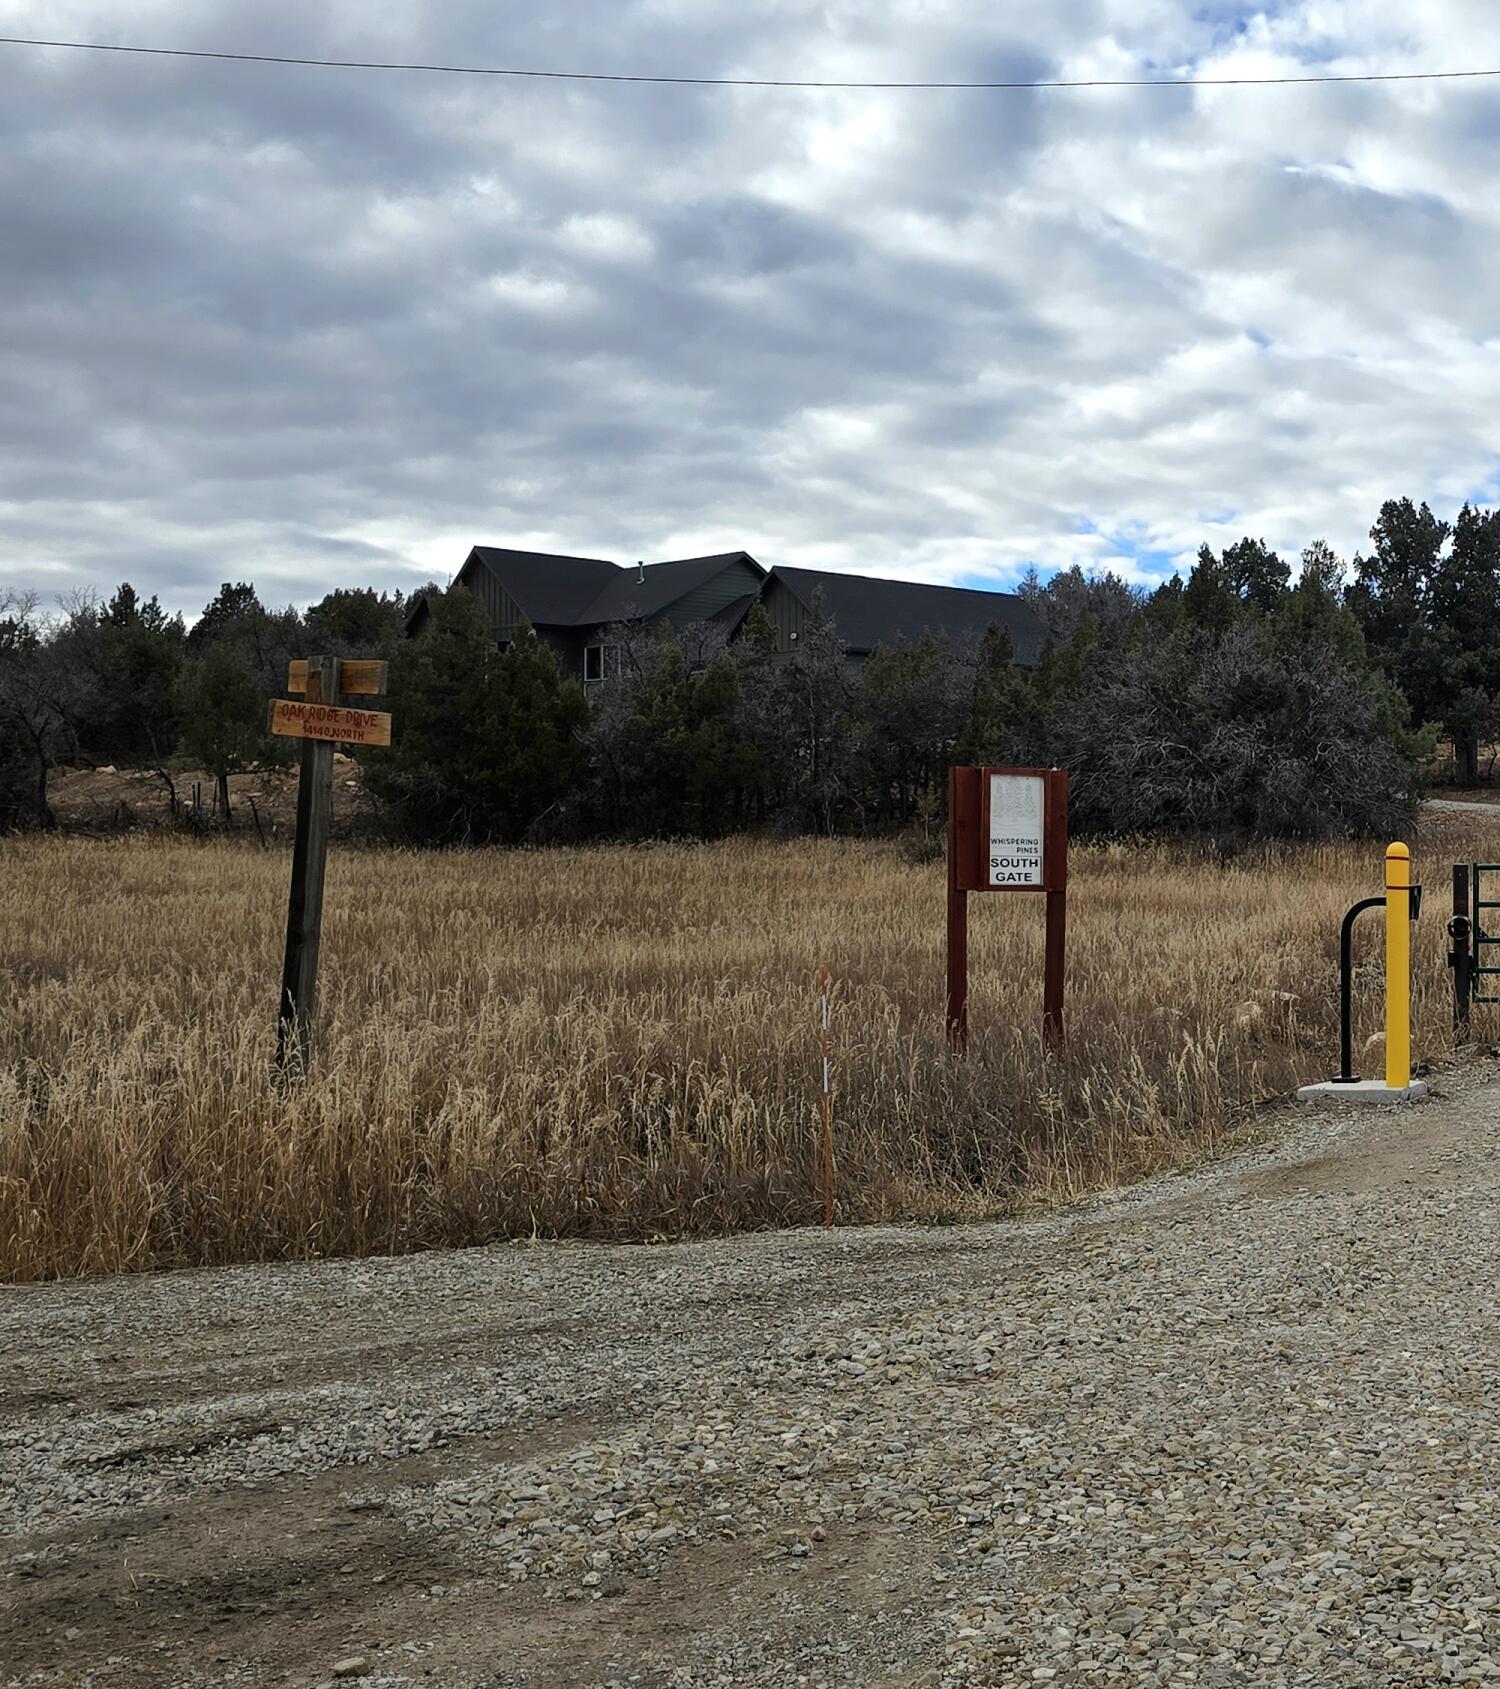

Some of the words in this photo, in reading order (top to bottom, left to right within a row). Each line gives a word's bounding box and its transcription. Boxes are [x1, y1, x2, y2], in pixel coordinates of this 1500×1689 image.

[281, 703, 306, 718] OAK
[308, 706, 341, 723] RIDGE
[331, 727, 365, 740] NORTH
[990, 858, 1039, 868] SOUTH
[995, 872, 1033, 882] GATE
